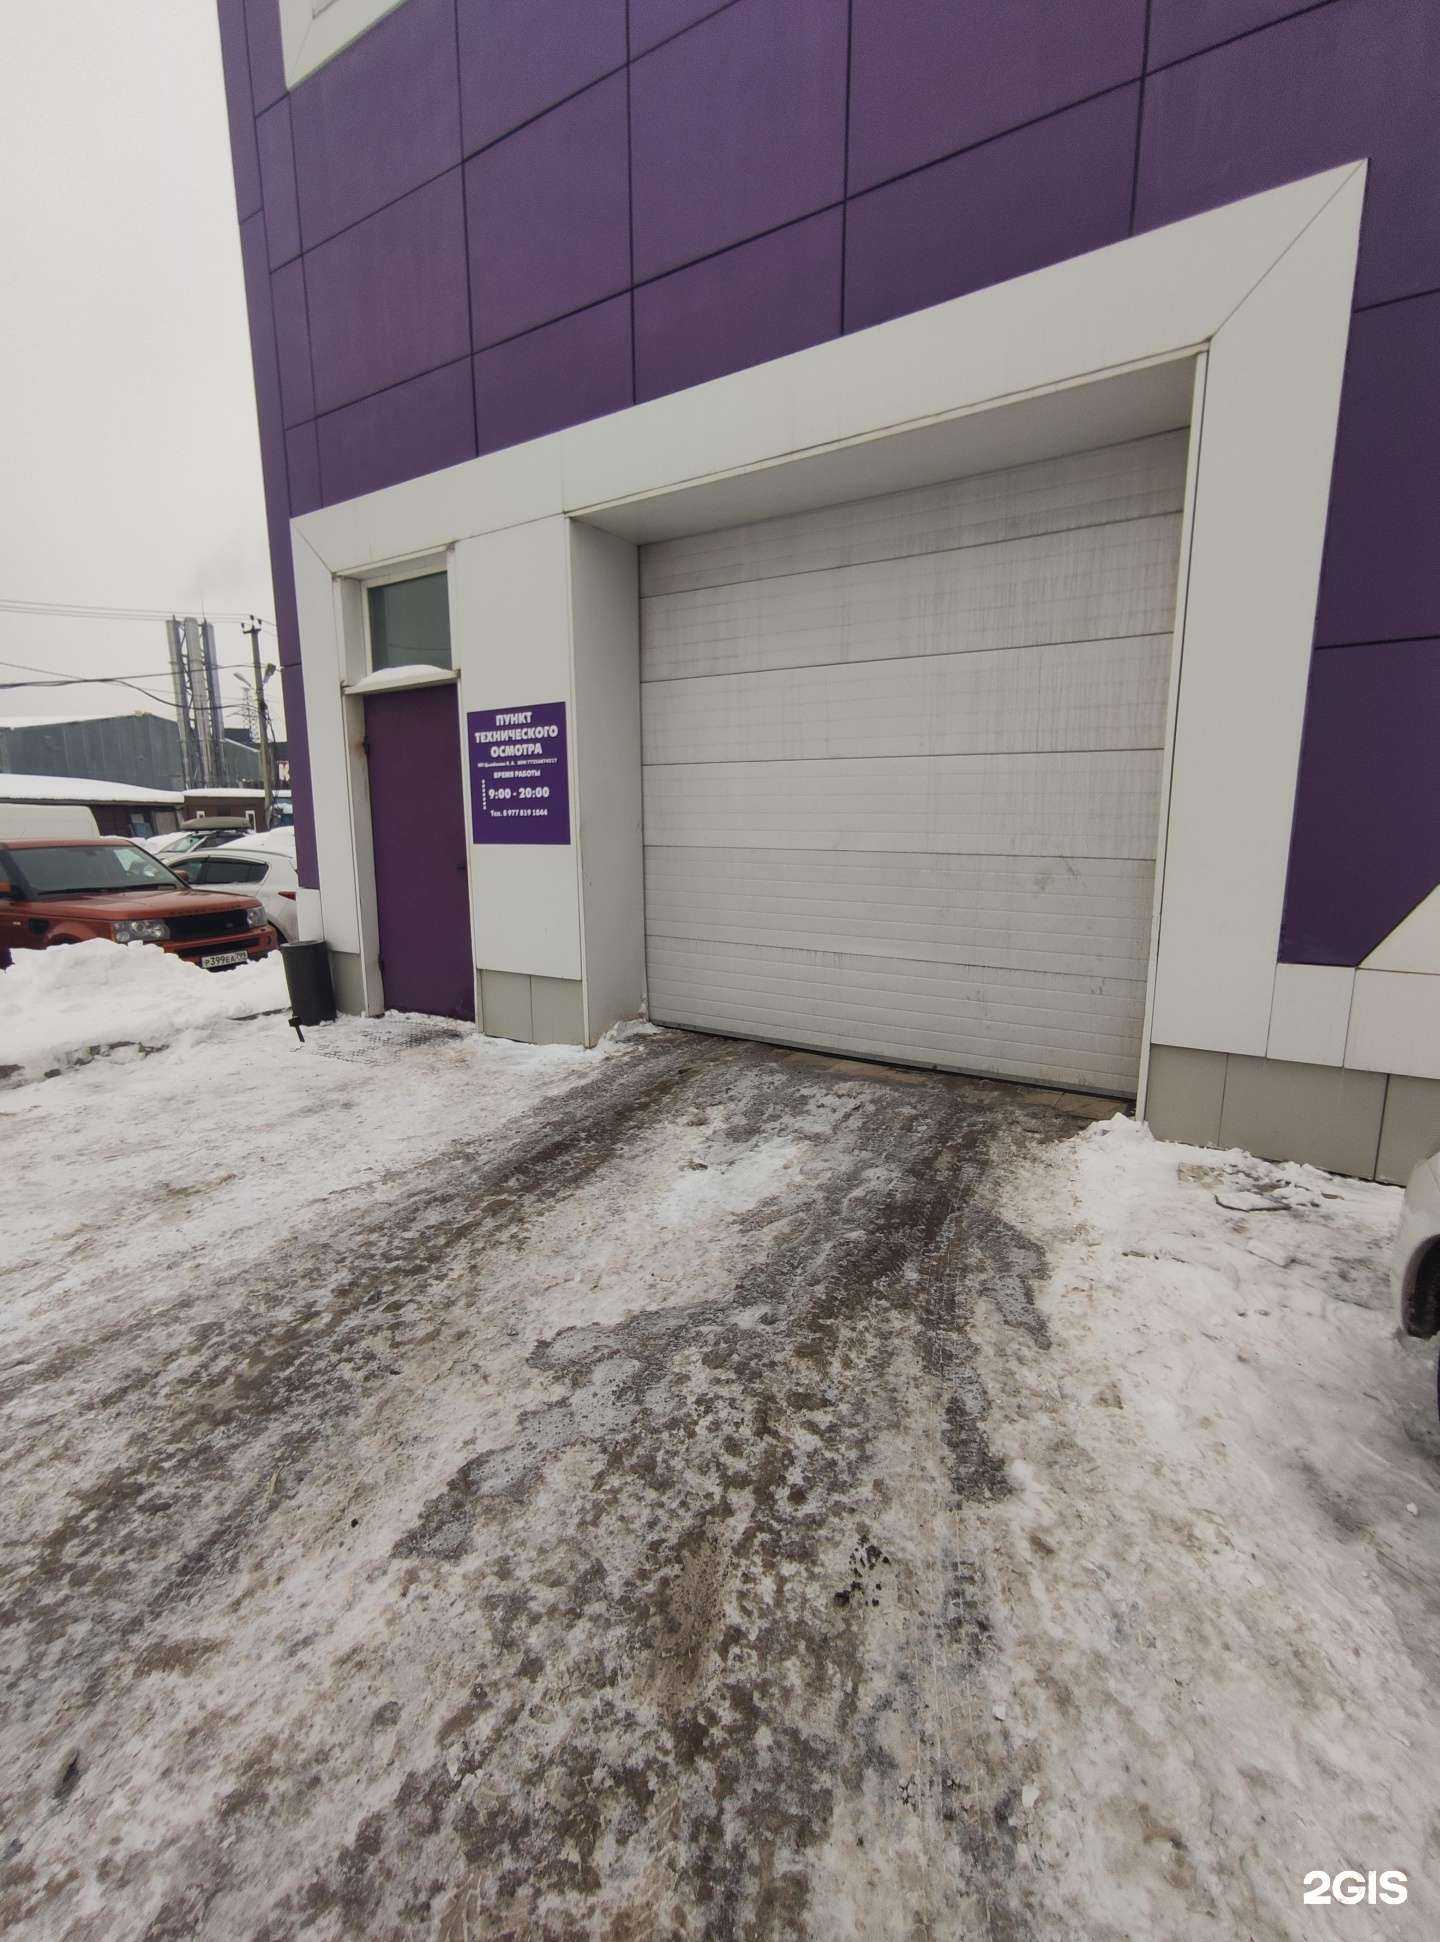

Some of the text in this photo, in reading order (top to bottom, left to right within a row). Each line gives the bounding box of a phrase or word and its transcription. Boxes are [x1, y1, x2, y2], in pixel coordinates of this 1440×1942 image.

[496, 711, 532, 726] ПУНКТ
[475, 725, 558, 743] ТЕХНИЧЕСКОГО
[490, 742, 543, 758] ОСМОТРА
[514, 769, 541, 778] РАБОТЫ
[488, 788, 511, 799] 9:00
[518, 786, 550, 799] 20:00
